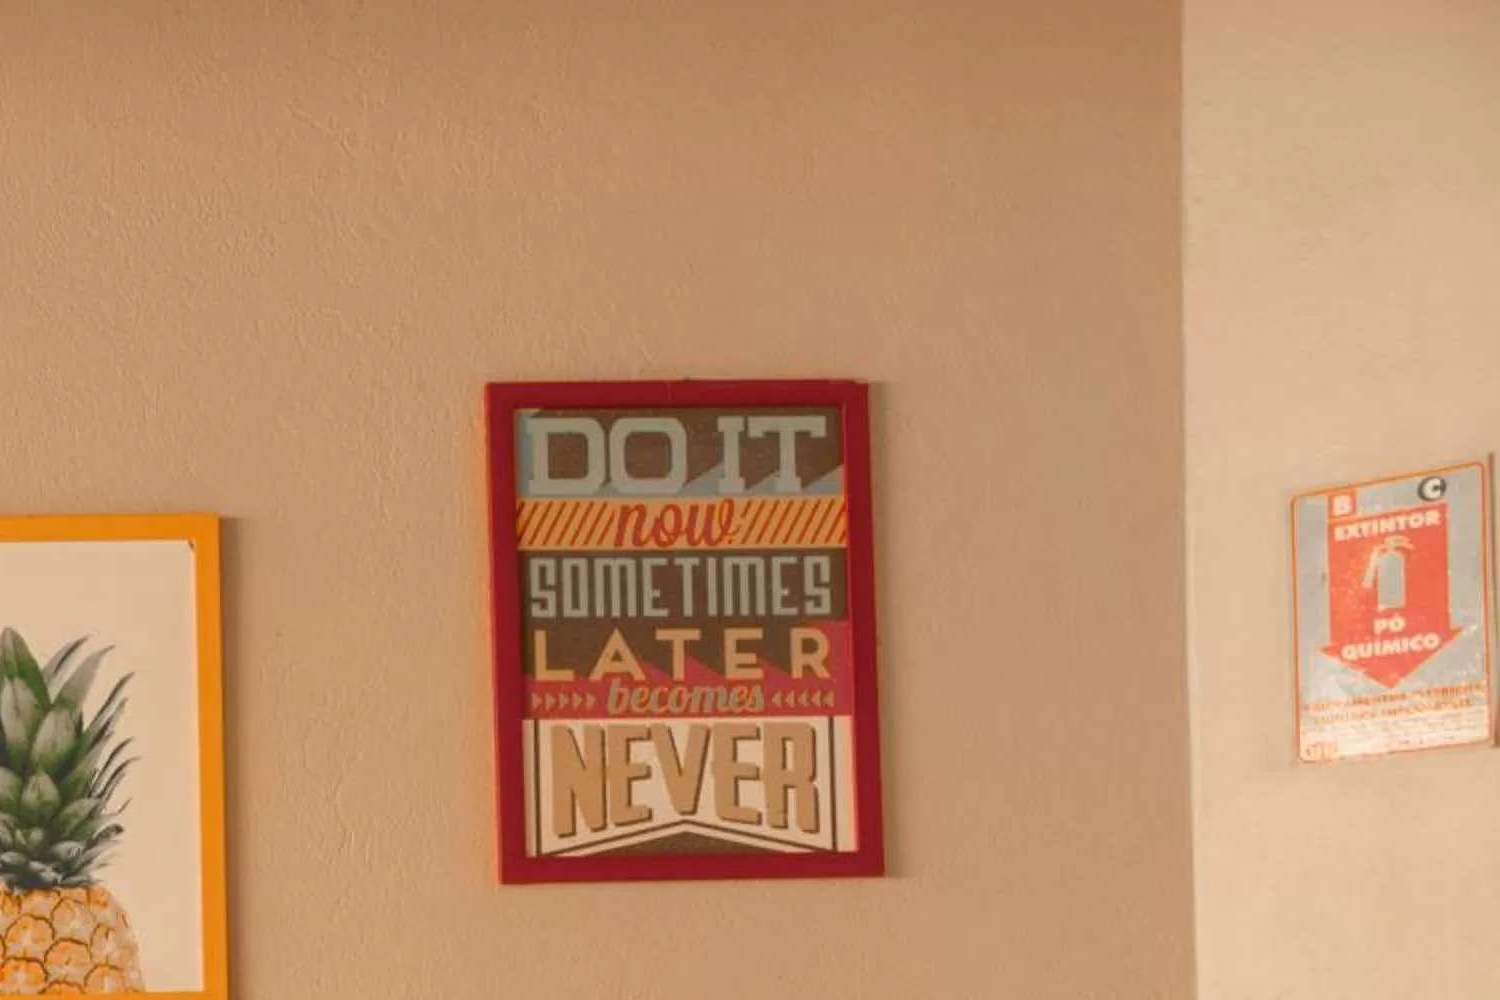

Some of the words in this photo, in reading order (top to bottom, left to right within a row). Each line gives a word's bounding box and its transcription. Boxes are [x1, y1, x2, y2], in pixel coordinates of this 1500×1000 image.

[526, 416, 688, 496] DO
[717, 415, 828, 494] IT
[613, 498, 736, 548] now
[1332, 495, 1353, 517] B
[1334, 509, 1442, 542] EXTINTOR
[529, 555, 832, 619] SOMETIMES
[534, 627, 832, 683] LATER
[606, 677, 764, 716] becomes
[549, 720, 820, 839] NEVER
